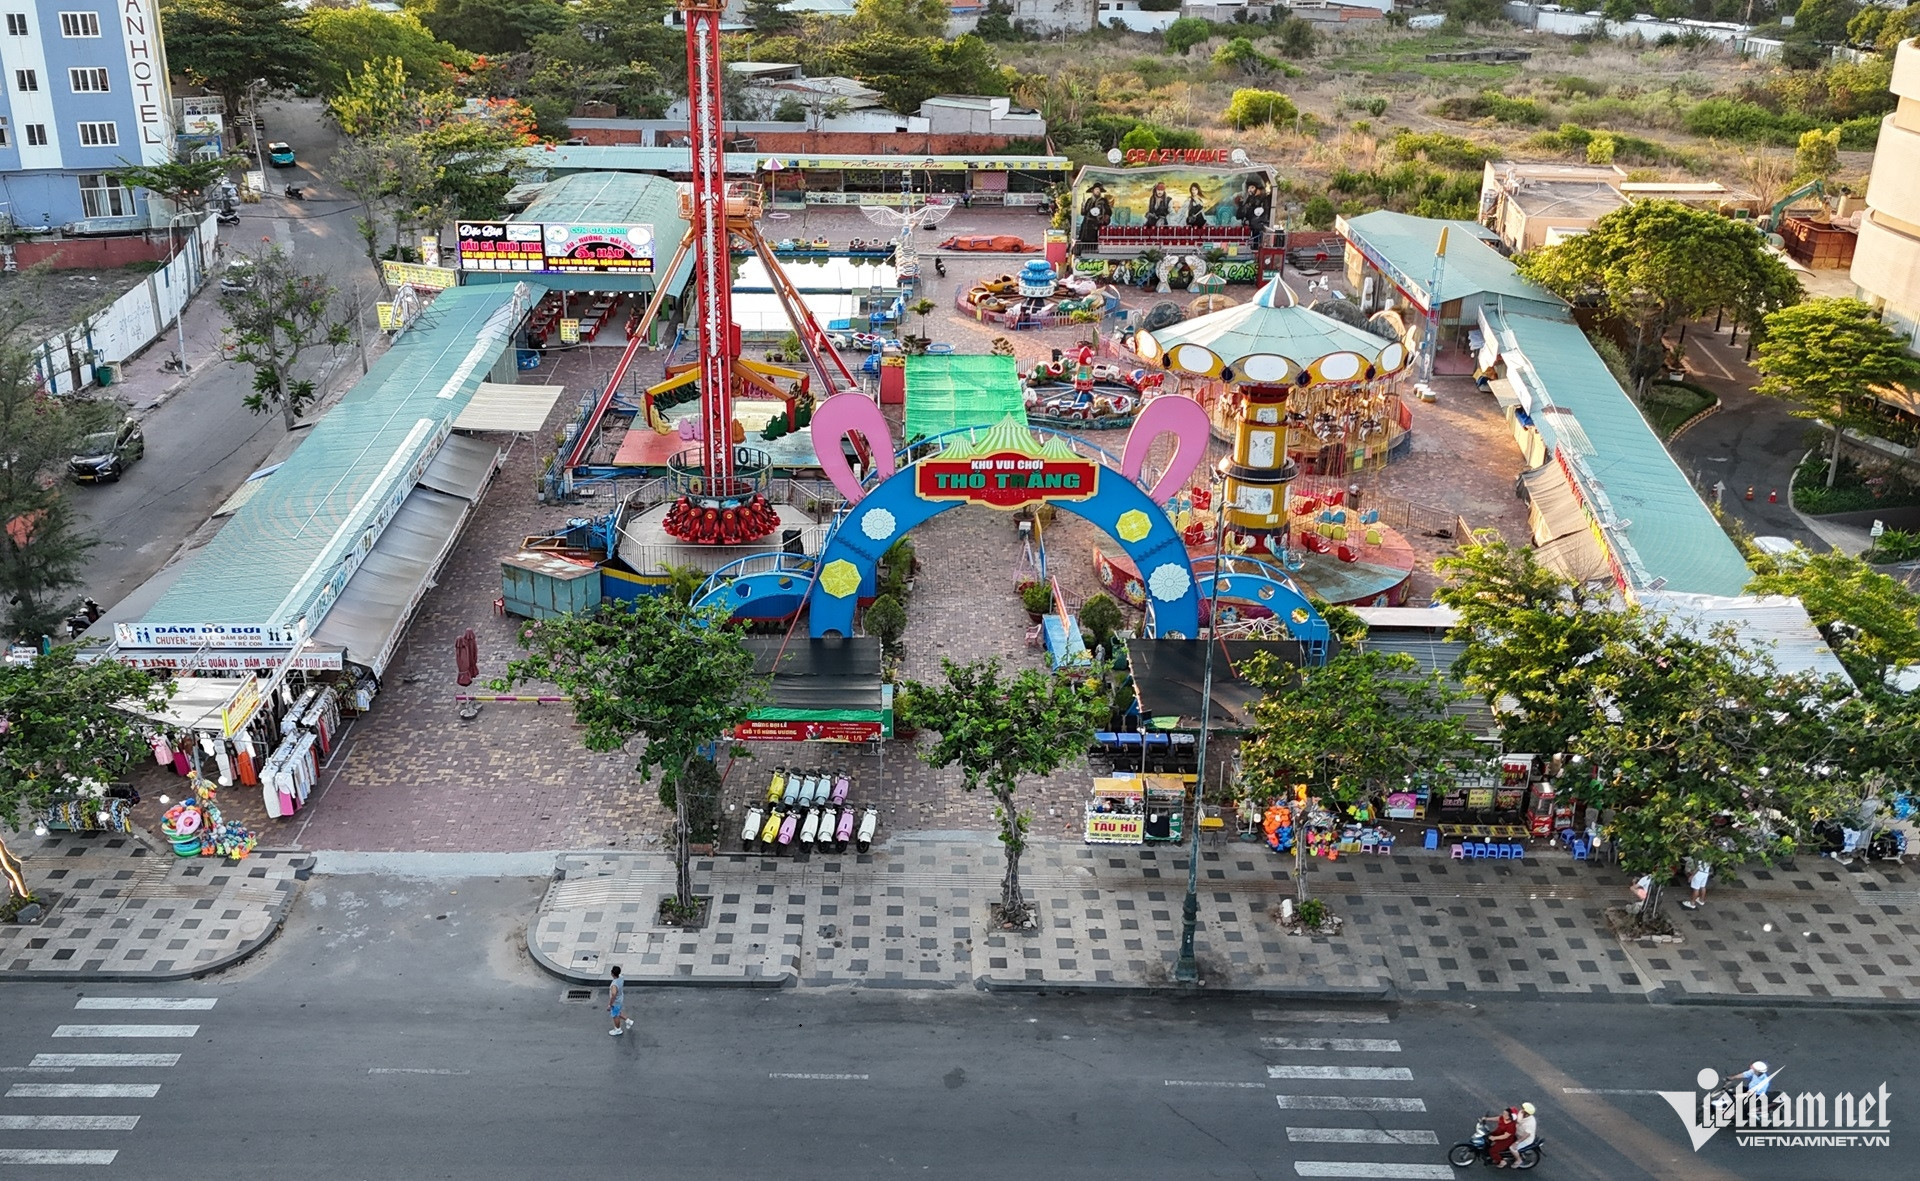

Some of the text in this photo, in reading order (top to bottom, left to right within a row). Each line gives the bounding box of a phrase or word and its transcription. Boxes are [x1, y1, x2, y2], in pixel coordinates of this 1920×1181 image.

[1126, 148, 1228, 163] CRAZY WAVE
[480, 240, 495, 251] CÁ
[1076, 260, 1105, 272] GAME
[971, 459, 1044, 470] KHU VUI CHƠI
[935, 469, 1080, 489] THỎ TRẮNG
